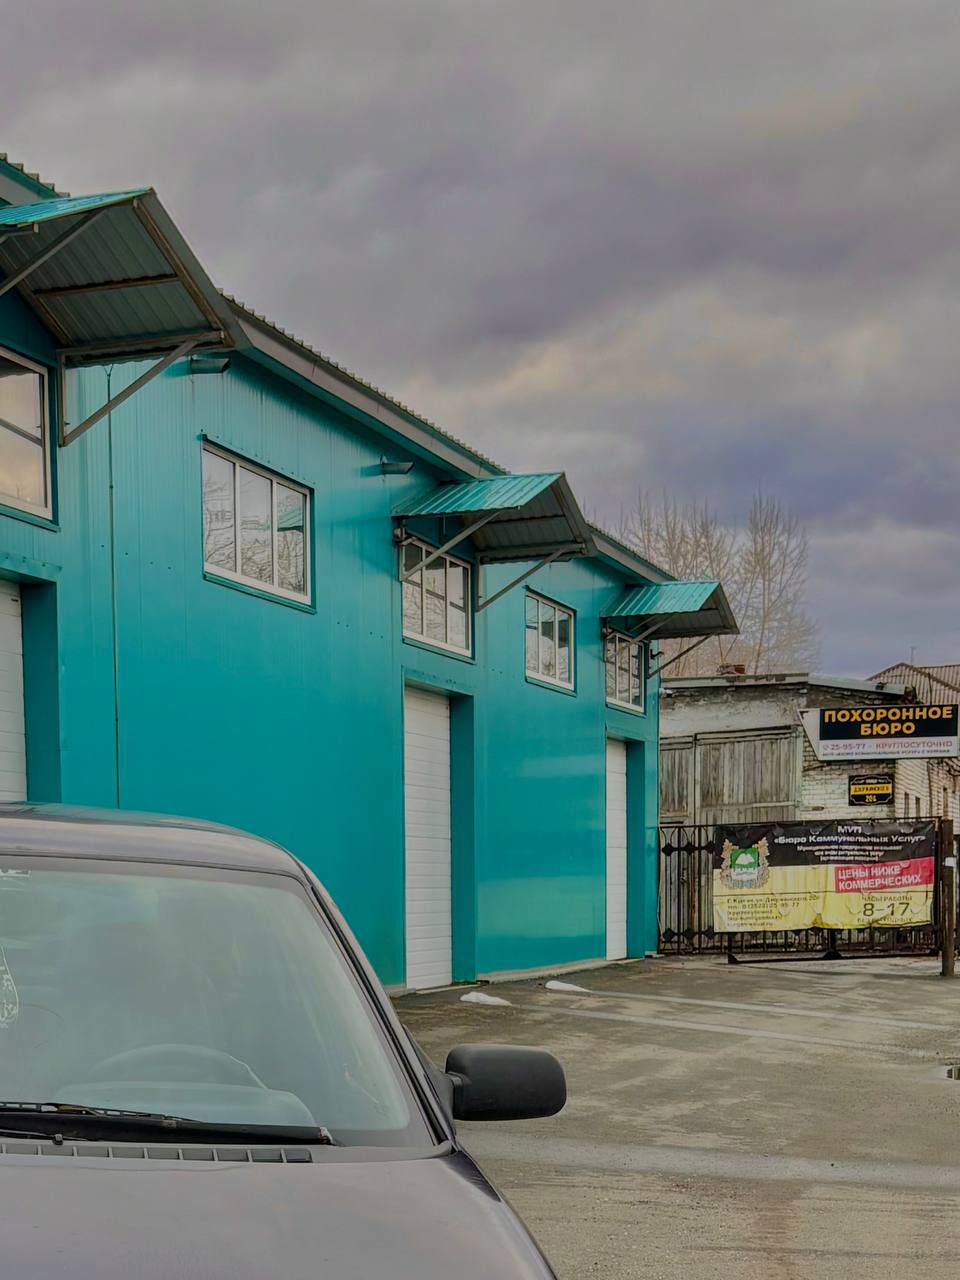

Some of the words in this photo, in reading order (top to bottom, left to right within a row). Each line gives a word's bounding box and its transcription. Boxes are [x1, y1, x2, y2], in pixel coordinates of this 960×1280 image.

[824, 706, 953, 723] ПОХОРОННОЕ
[860, 721, 916, 736] БЮРО
[875, 740, 953, 750] КРУГЛОСУТОЧНО
[837, 825, 862, 834] МУП
[838, 867, 869, 879] ЦЕНЫ
[871, 865, 901, 876] НИЖЕ
[839, 874, 921, 890] КОММЕРЧЕСКИХ
